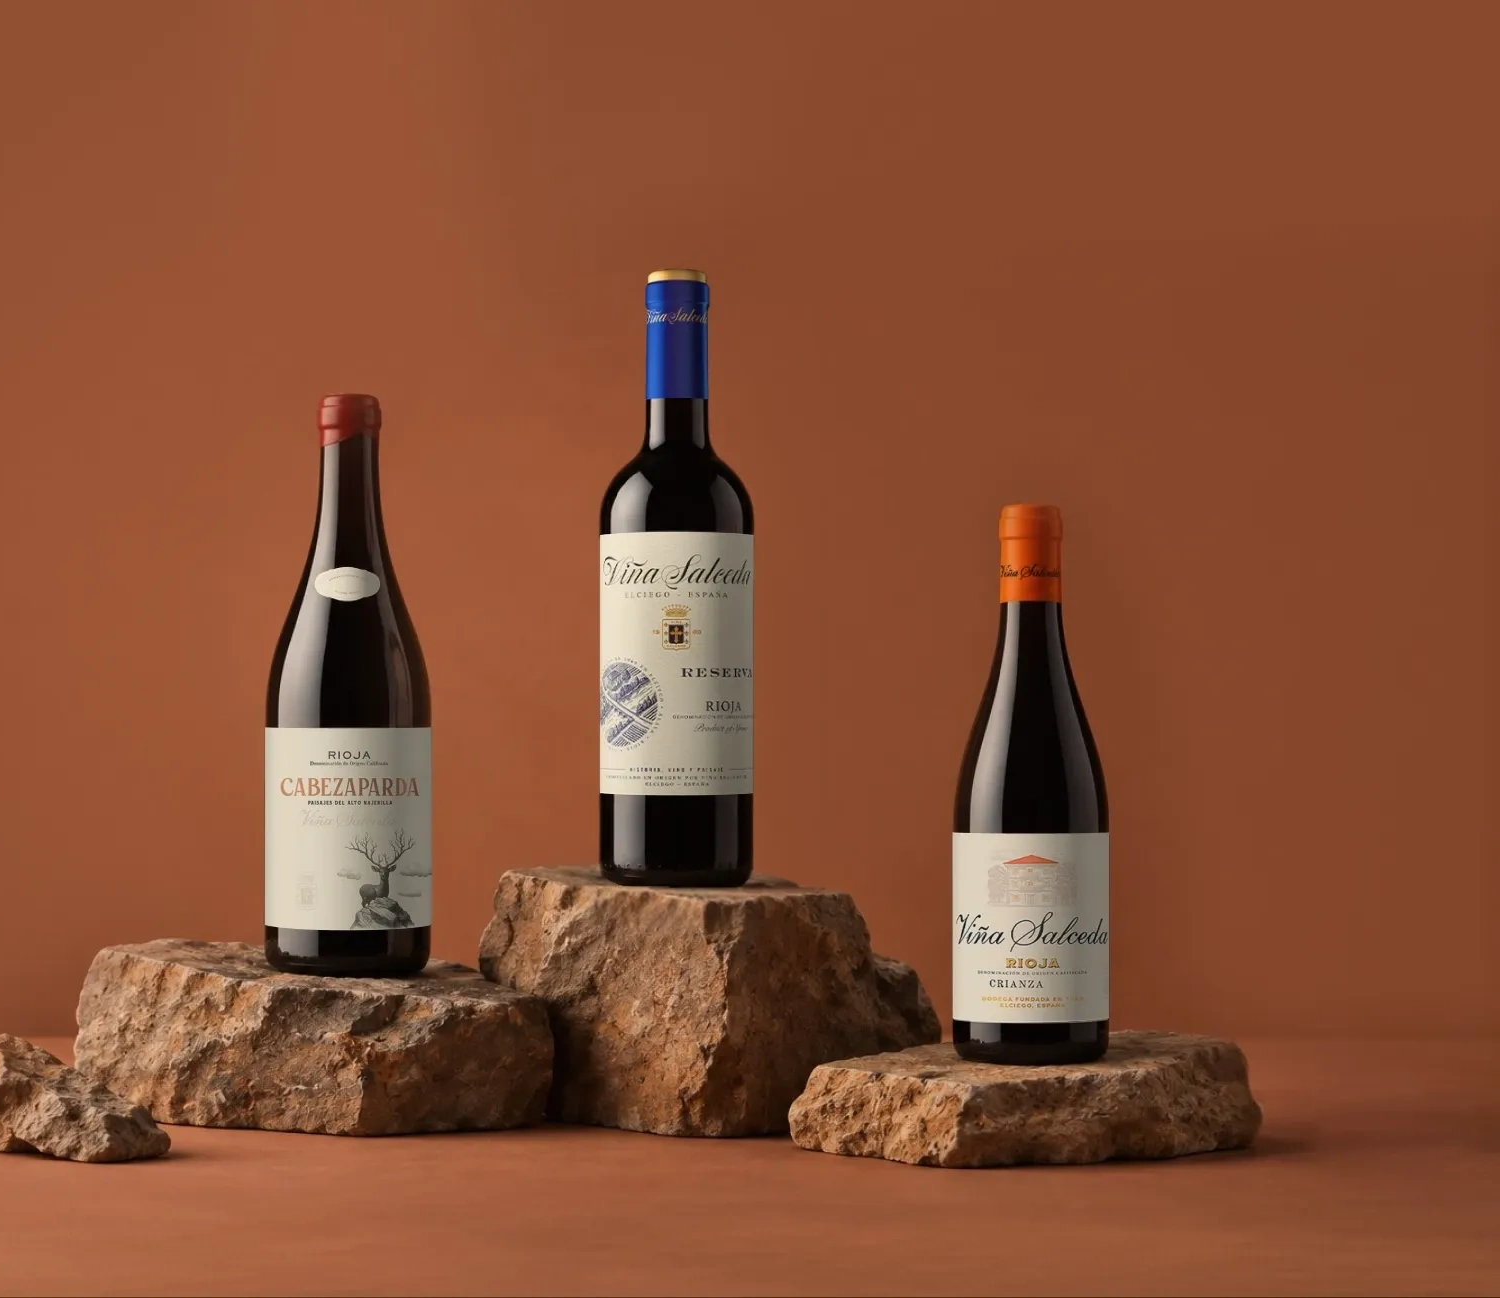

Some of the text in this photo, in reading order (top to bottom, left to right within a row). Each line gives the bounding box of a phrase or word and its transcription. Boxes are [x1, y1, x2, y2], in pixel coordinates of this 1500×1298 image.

[603, 554, 752, 590] Viña Salceda
[624, 591, 671, 599] ELCIEGO
[688, 590, 728, 599] ESPAÑA
[681, 667, 752, 678] RESERVA
[705, 700, 742, 713] RIOJA
[327, 750, 371, 760] RIOJA
[280, 778, 420, 797] CABEZAPARDA
[956, 911, 1109, 952] Viña Salceda
[1005, 957, 1060, 969] RIOJA
[989, 978, 1044, 989] CRIANZA
